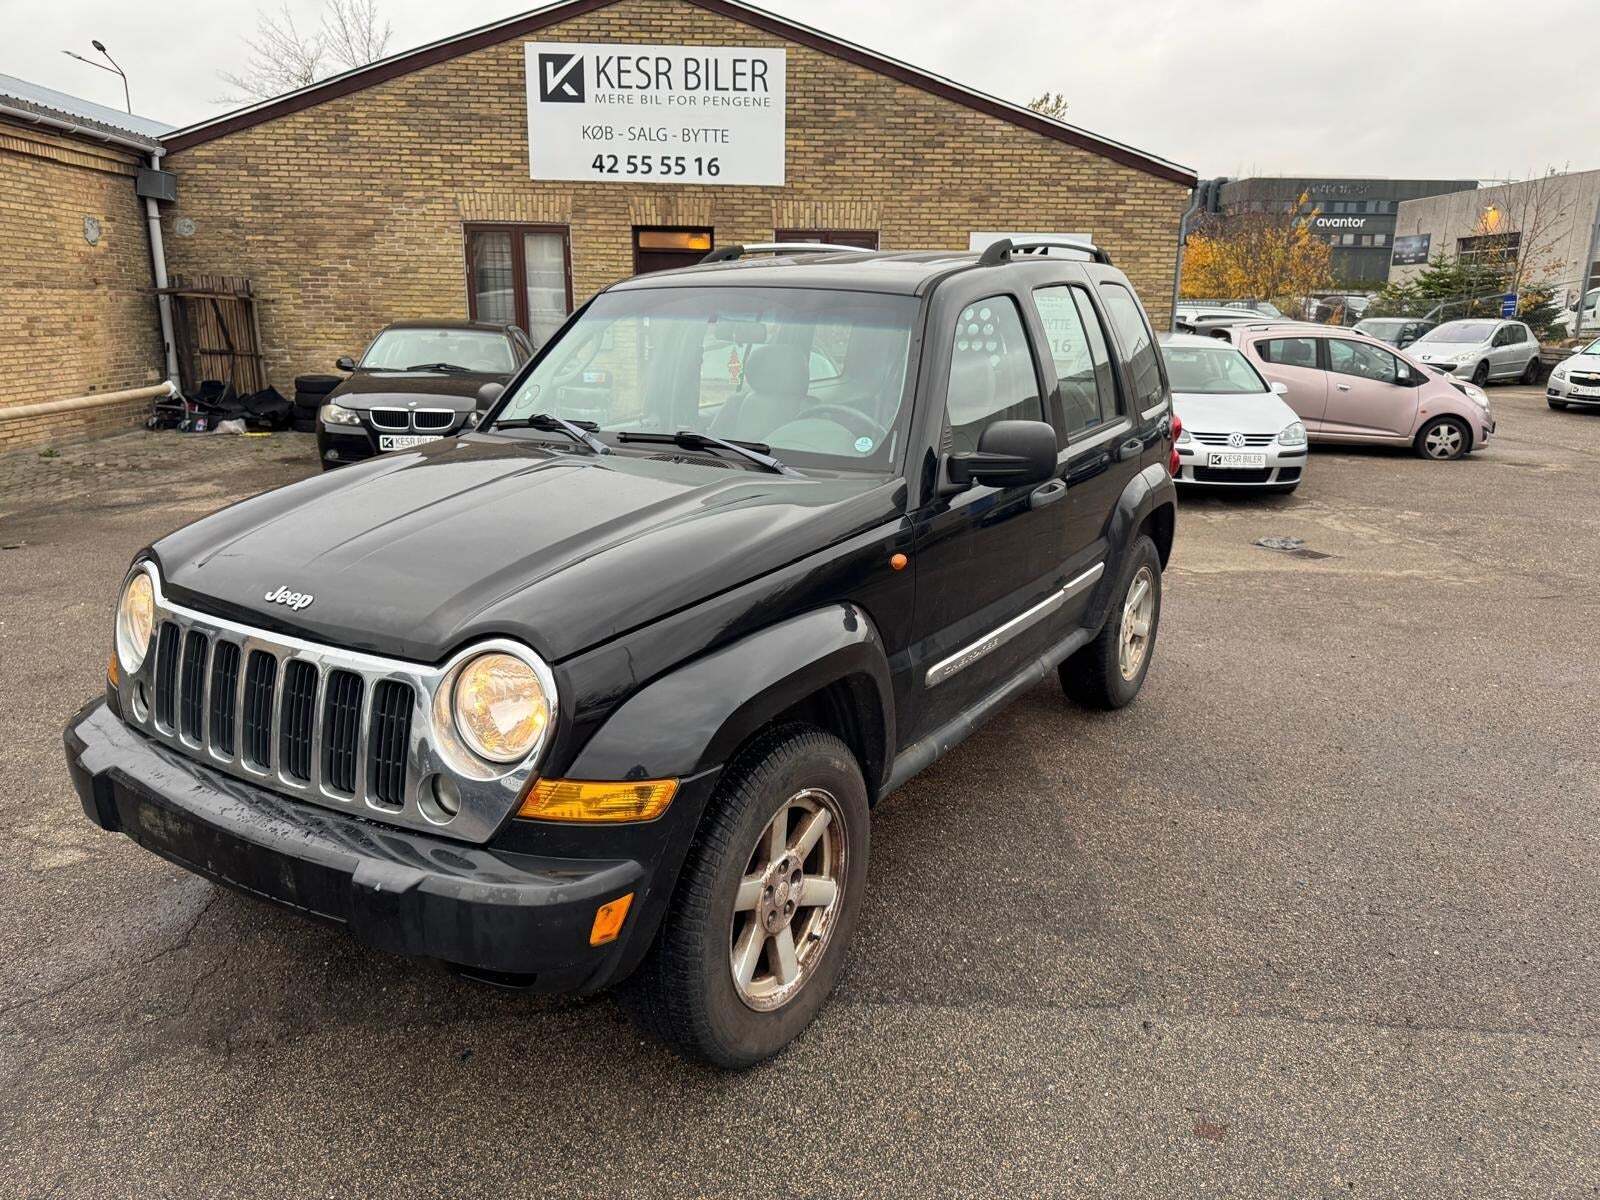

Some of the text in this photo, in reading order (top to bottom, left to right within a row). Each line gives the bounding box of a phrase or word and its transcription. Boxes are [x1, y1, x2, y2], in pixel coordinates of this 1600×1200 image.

[595, 55, 768, 92] KESR BILER
[595, 94, 771, 107] MERE BIL FOR PENGENE
[582, 125, 613, 140] KØB
[628, 127, 667, 141] SALG
[682, 128, 729, 143] BYTTE
[592, 154, 720, 176] 42 55 55 16
[1316, 216, 1366, 228] avantor
[1053, 339, 1073, 353] 16
[1224, 455, 1241, 463] KESR
[1243, 455, 1263, 464] BILER
[264, 585, 314, 611] Jeep
